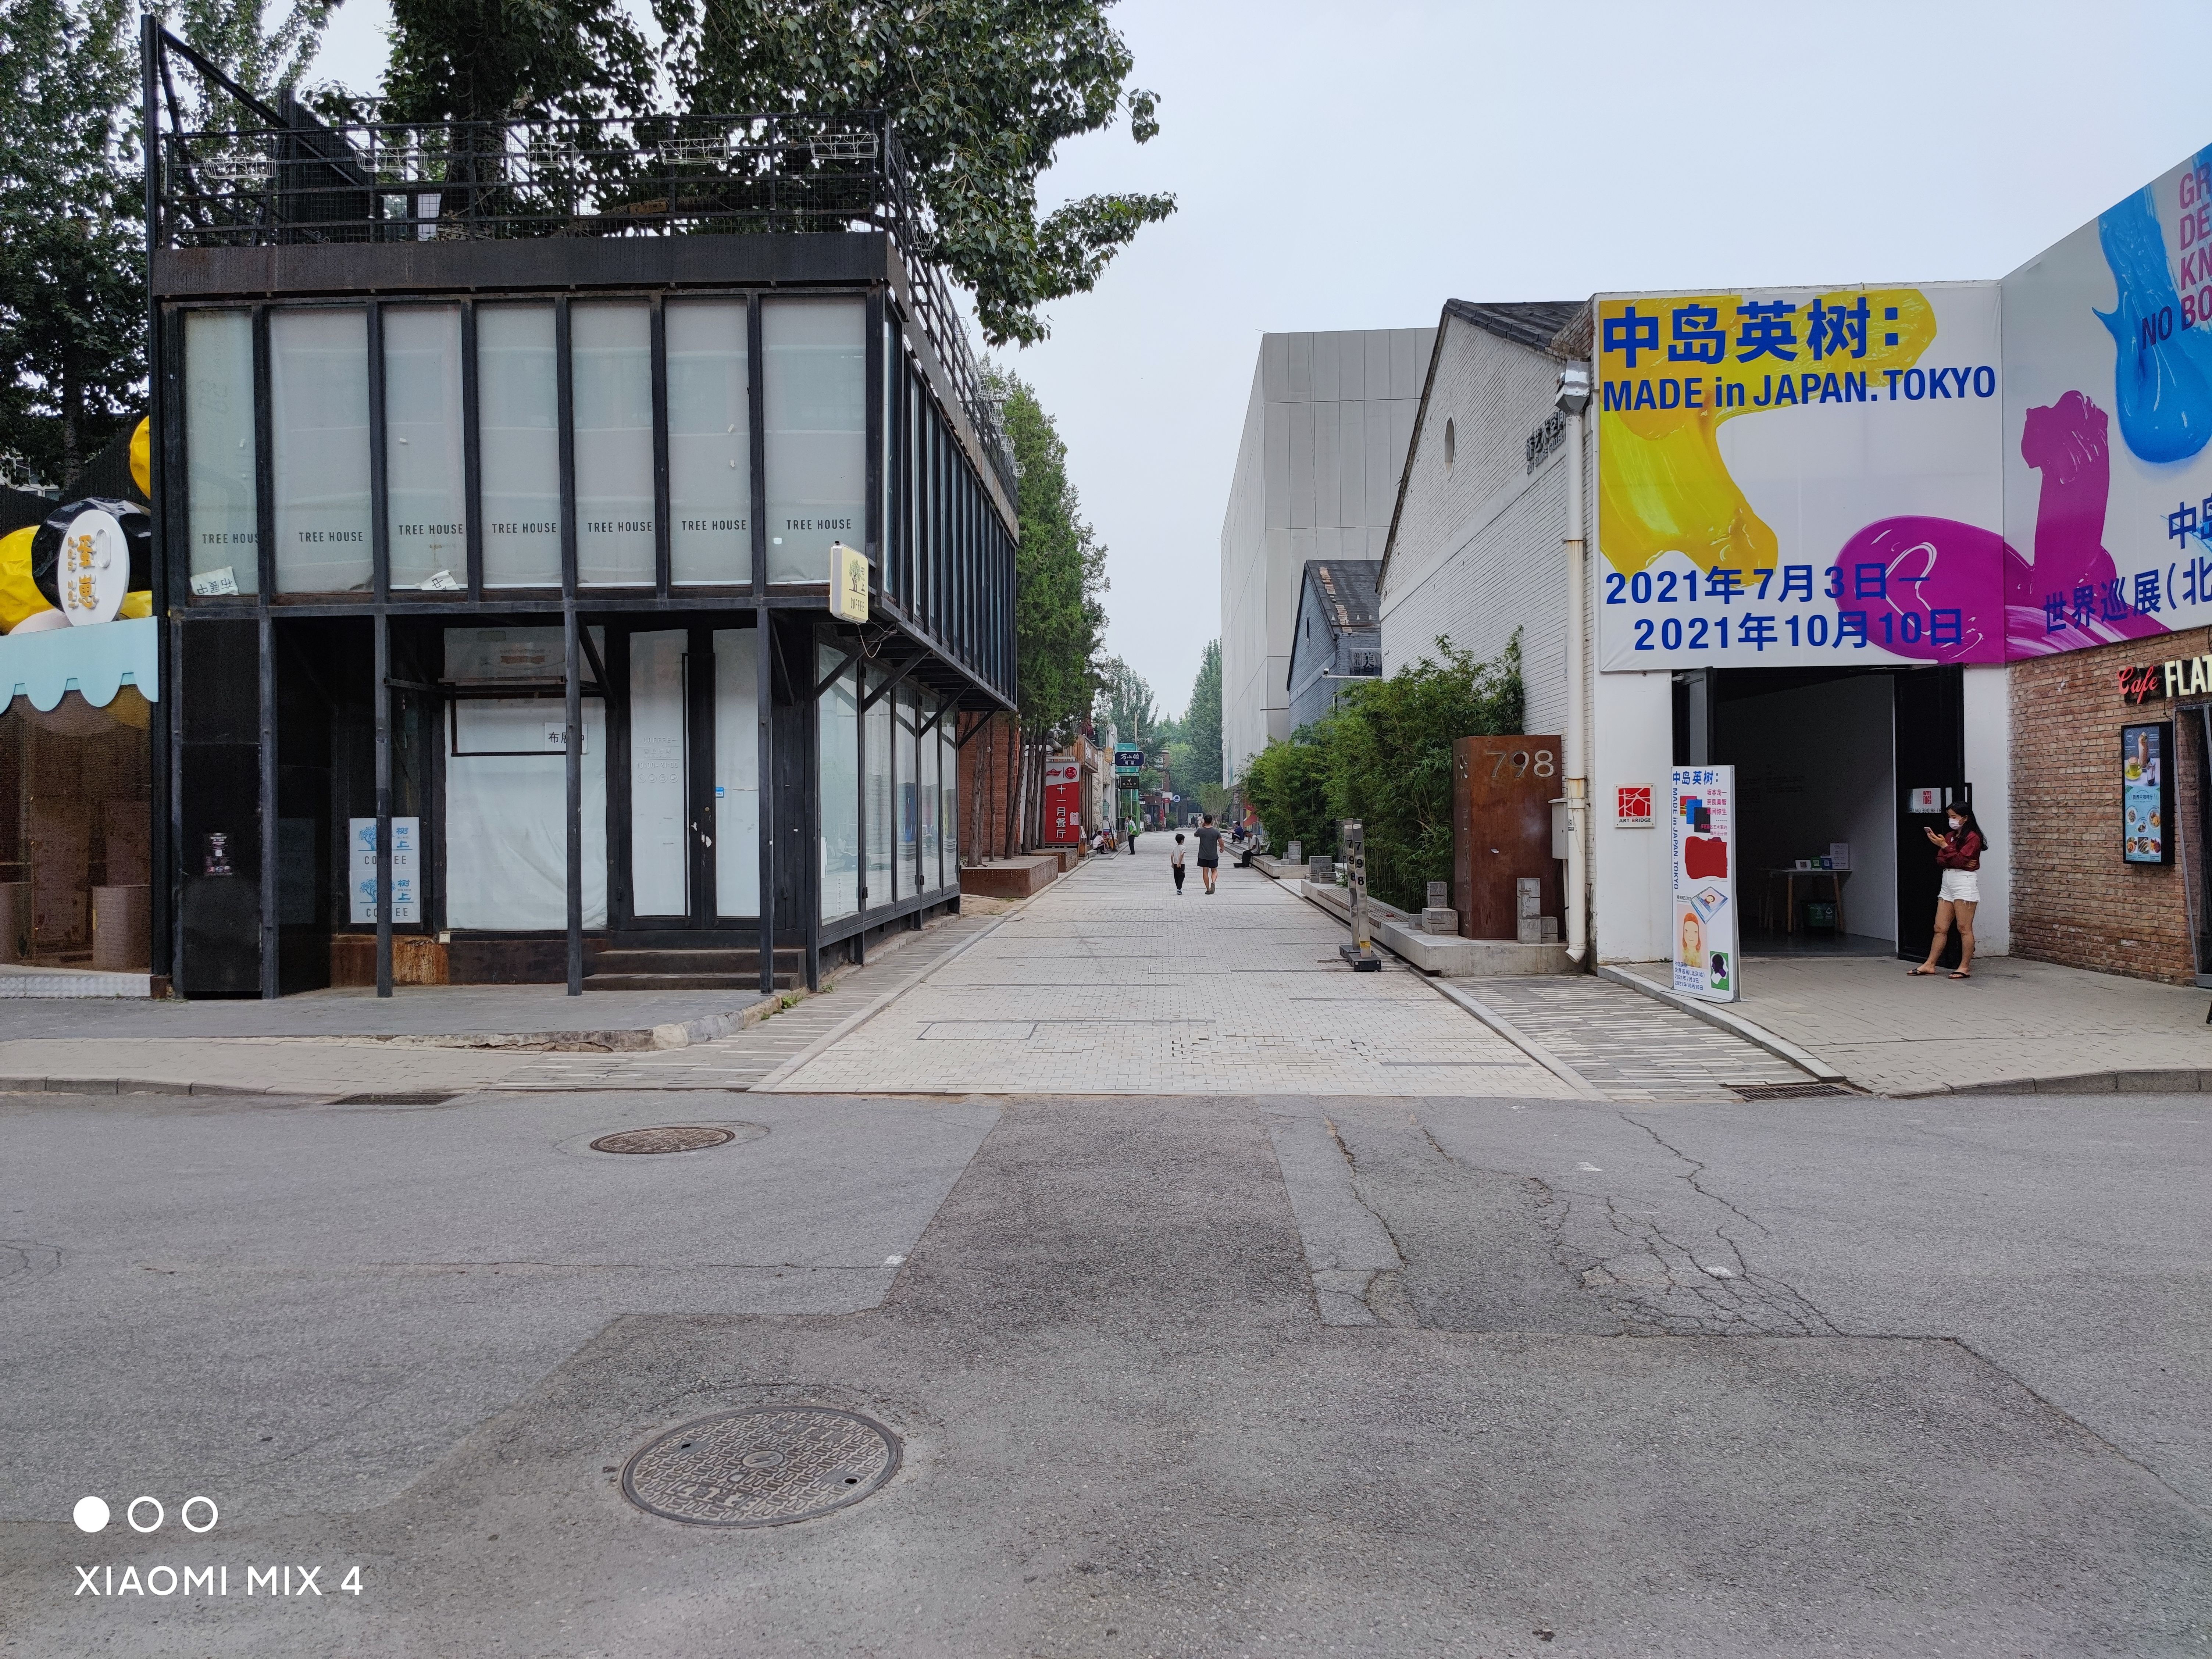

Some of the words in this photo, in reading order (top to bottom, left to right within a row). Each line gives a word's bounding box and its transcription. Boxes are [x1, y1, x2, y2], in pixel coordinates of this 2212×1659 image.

[1602, 297, 1898, 368] 中岛英树:
[2143, 306, 2172, 349] NO
[1602, 377, 1703, 411] MADE
[1715, 375, 1745, 407] in
[399, 525, 424, 535] TREE
[429, 524, 463, 534] HOUSE
[492, 523, 517, 534] TREE
[522, 522, 557, 533] HOUSE
[588, 522, 613, 532] TREE
[618, 521, 652, 532] HOUSE
[682, 520, 707, 531] TREE
[712, 520, 746, 530] HOUSE
[786, 519, 811, 530] TREE
[817, 518, 852, 529] HOUSE
[203, 534, 228, 544] TREE
[233, 534, 258, 543] HOUS
[299, 532, 324, 542] TREE
[329, 532, 363, 542] HOUSE
[850, 597, 864, 612] COFFEE
[1634, 608, 1962, 651] 2021年10月10日
[2117, 666, 2158, 704] Cafe
[1486, 750, 1555, 778] 798
[1673, 770, 1718, 785] 中岛英树:
[1056, 785, 1067, 839] 十一月餐厅
[1673, 817, 1678, 825] in
[365, 856, 406, 864] COEE
[1347, 839, 1356, 881] 798
[1355, 841, 1364, 885] 798
[366, 908, 408, 917] COEE
[1675, 981, 1703, 990] 2021年10月10日
